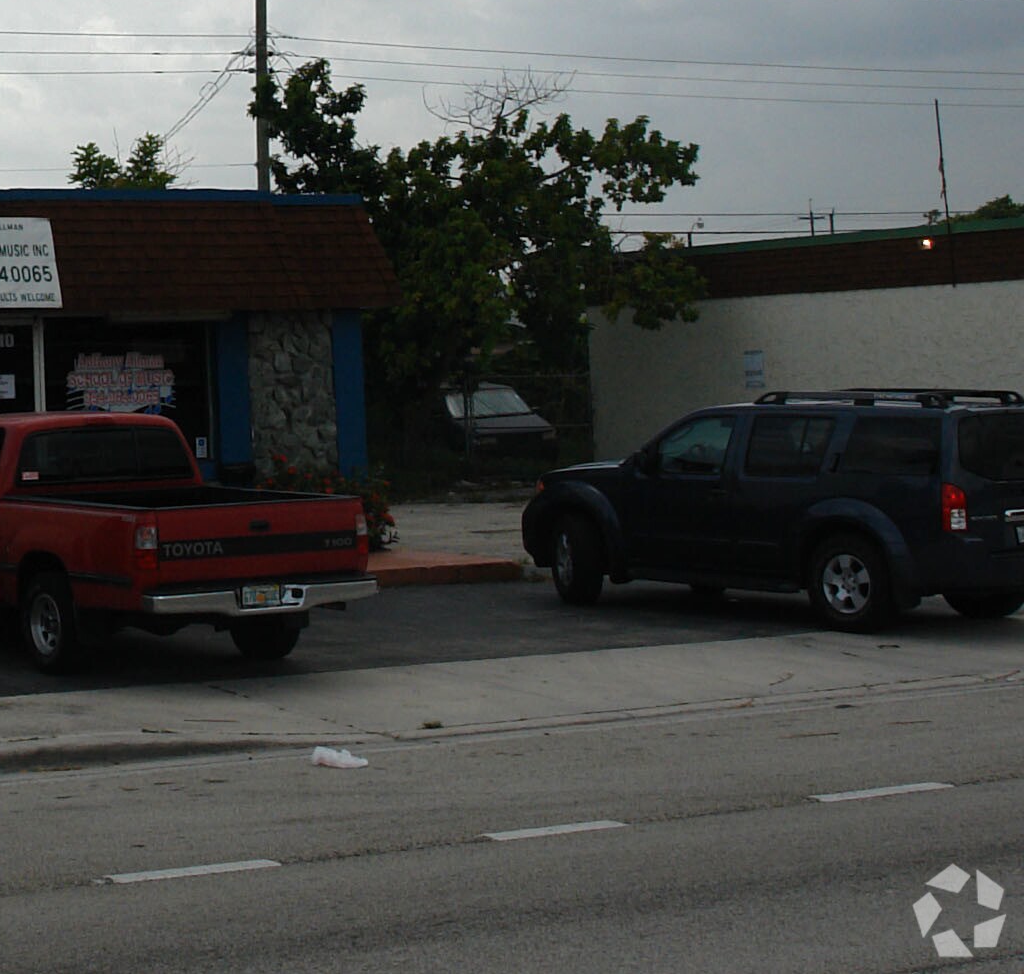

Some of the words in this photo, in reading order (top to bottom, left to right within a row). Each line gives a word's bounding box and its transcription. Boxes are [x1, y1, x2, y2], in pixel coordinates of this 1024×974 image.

[0, 244, 29, 257] MUSIC
[33, 244, 49, 257] INC
[21, 293, 56, 302] WELCOME
[67, 370, 113, 387] SCHOOL
[117, 370, 134, 387] OF
[136, 369, 175, 386] MUSIC
[163, 541, 224, 557] TOYOTA
